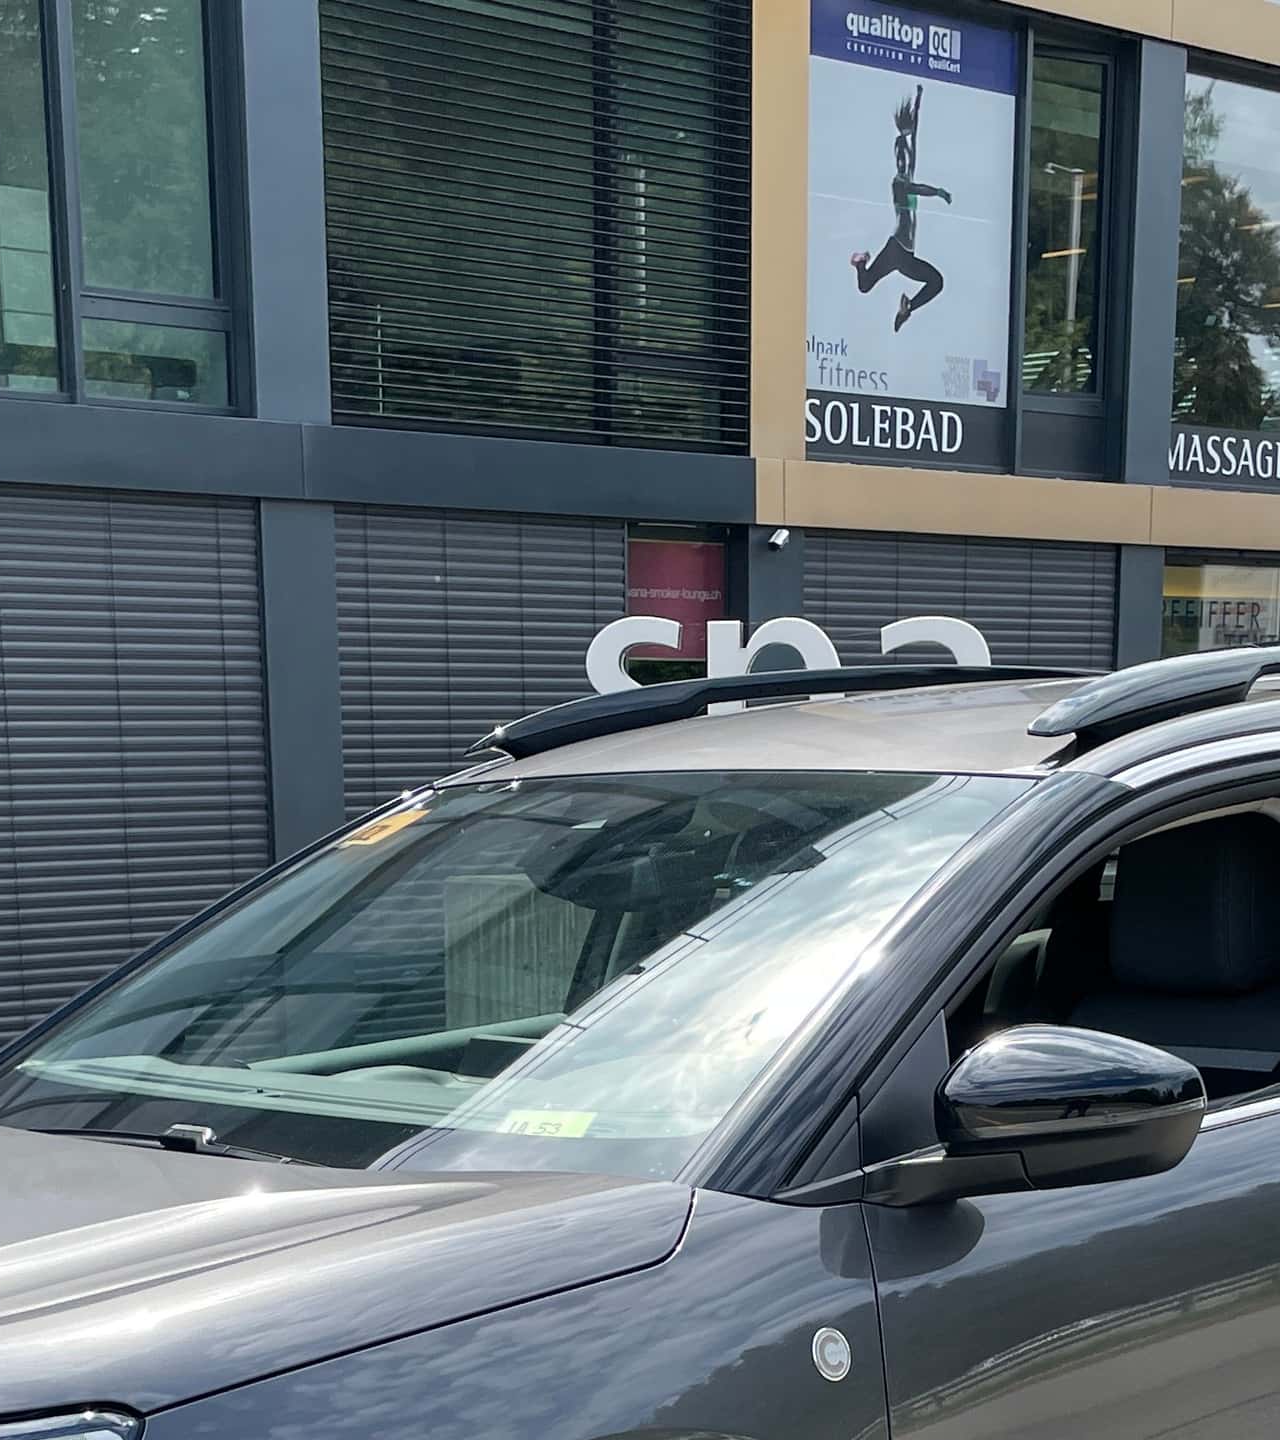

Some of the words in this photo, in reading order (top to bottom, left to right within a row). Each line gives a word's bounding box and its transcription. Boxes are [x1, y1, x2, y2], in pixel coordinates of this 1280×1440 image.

[846, 12, 924, 49] qualitop
[818, 357, 888, 391] fitness
[804, 398, 963, 453] SOLEBAD
